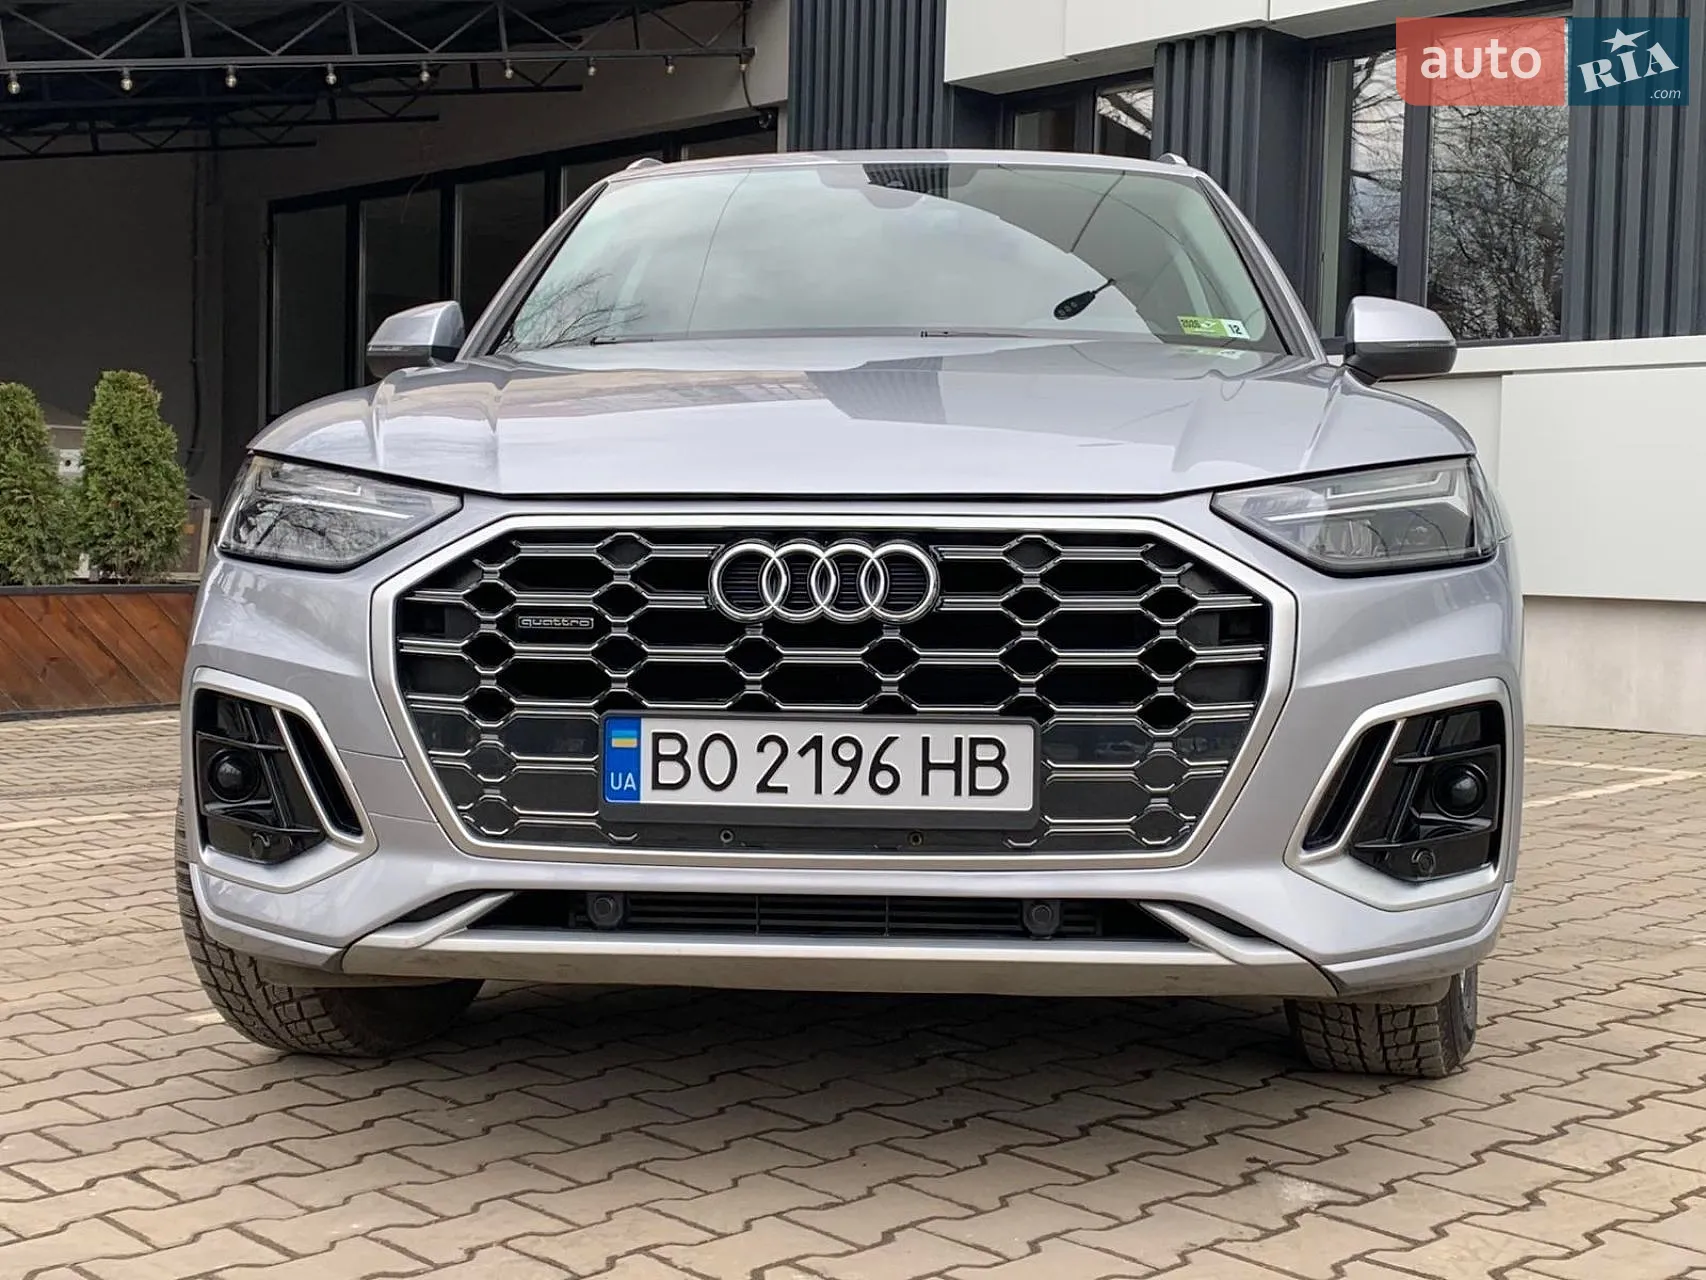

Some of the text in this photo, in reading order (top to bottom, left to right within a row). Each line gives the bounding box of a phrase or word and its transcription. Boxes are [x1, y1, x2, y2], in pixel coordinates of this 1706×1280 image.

[1228, 324, 1242, 335] 12
[521, 618, 590, 627] quattro
[651, 731, 1010, 797] BO 2196 HB
[610, 771, 637, 791] UA
